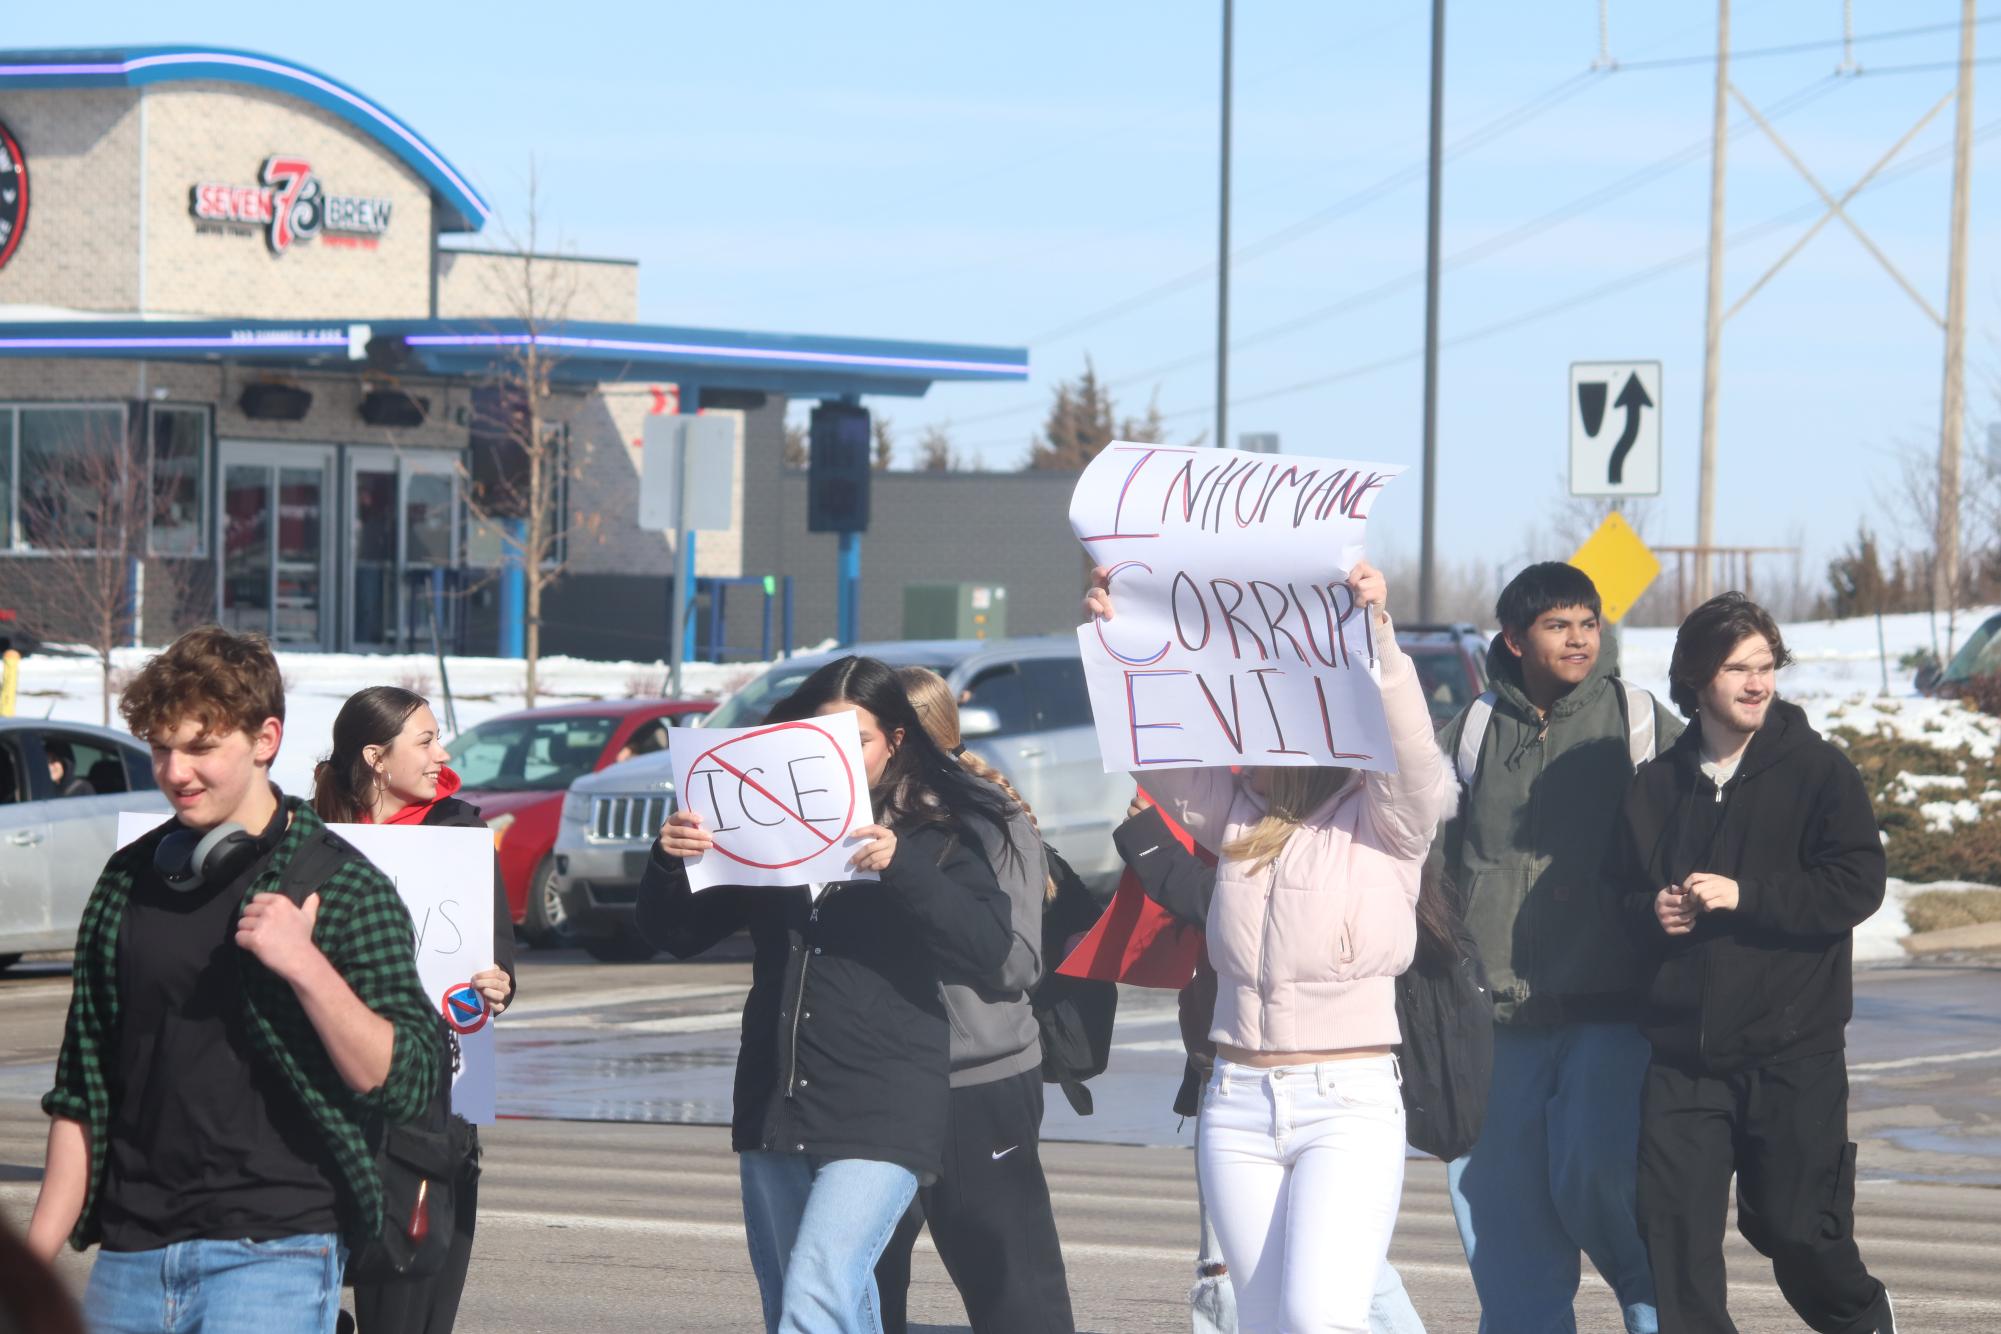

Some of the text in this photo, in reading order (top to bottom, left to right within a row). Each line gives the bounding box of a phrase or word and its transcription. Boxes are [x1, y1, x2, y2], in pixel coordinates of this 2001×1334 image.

[194, 183, 275, 222] SEVEN
[324, 196, 391, 232] BREW
[1080, 447, 1397, 542] INHUMANE
[1123, 668, 1373, 766] EVIL
[692, 755, 841, 833] ICE
